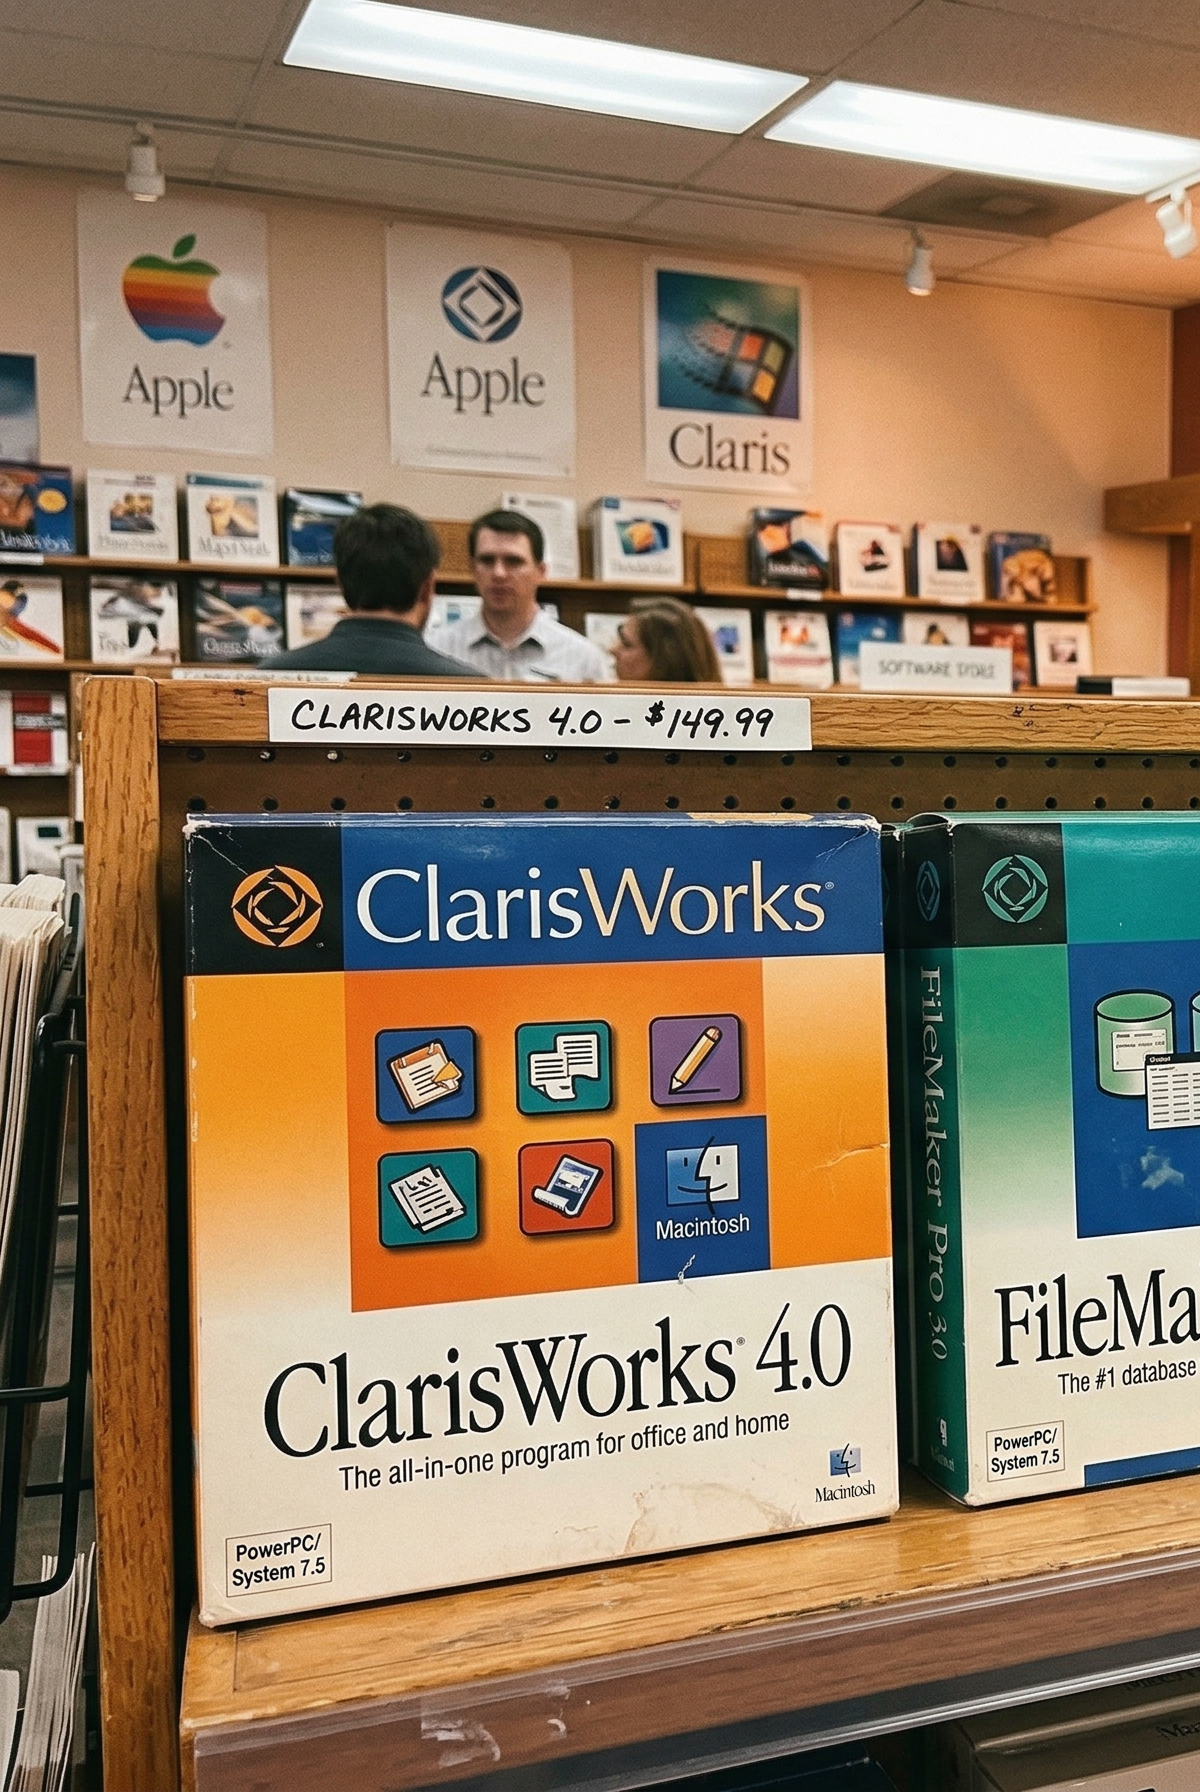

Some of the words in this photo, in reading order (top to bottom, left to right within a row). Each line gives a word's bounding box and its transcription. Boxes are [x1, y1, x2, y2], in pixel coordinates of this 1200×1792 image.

[122, 364, 235, 419] Apple
[420, 351, 546, 416] Apple
[670, 422, 790, 477] Claris
[291, 700, 532, 731] CLARISWORKS
[548, 707, 601, 735] 4.0
[645, 700, 775, 738] $149.99
[920, 966, 948, 1208] FileMaker
[655, 1212, 751, 1240] Macintosh
[927, 1219, 948, 1302] Pro
[928, 1311, 948, 1361] 3.0
[264, 1315, 738, 1459] ClarisWorks
[755, 1302, 853, 1396] 4.0
[1058, 1371, 1090, 1396] The
[1095, 1367, 1115, 1391] #1
[1121, 1357, 1197, 1388] database
[338, 1464, 382, 1493] The
[388, 1450, 494, 1485] all-in-one
[500, 1438, 590, 1476] program
[595, 1430, 625, 1456] for
[631, 1422, 687, 1451] office
[692, 1416, 729, 1442] and
[734, 1410, 791, 1436] home
[993, 1427, 1059, 1452] PowerPC/
[990, 1451, 1038, 1477] System
[1040, 1448, 1061, 1467] 7.5
[814, 1479, 876, 1503] Macintosh
[235, 1532, 322, 1564] PowerPC/
[231, 1559, 297, 1590] System
[298, 1556, 326, 1581] 7.5
